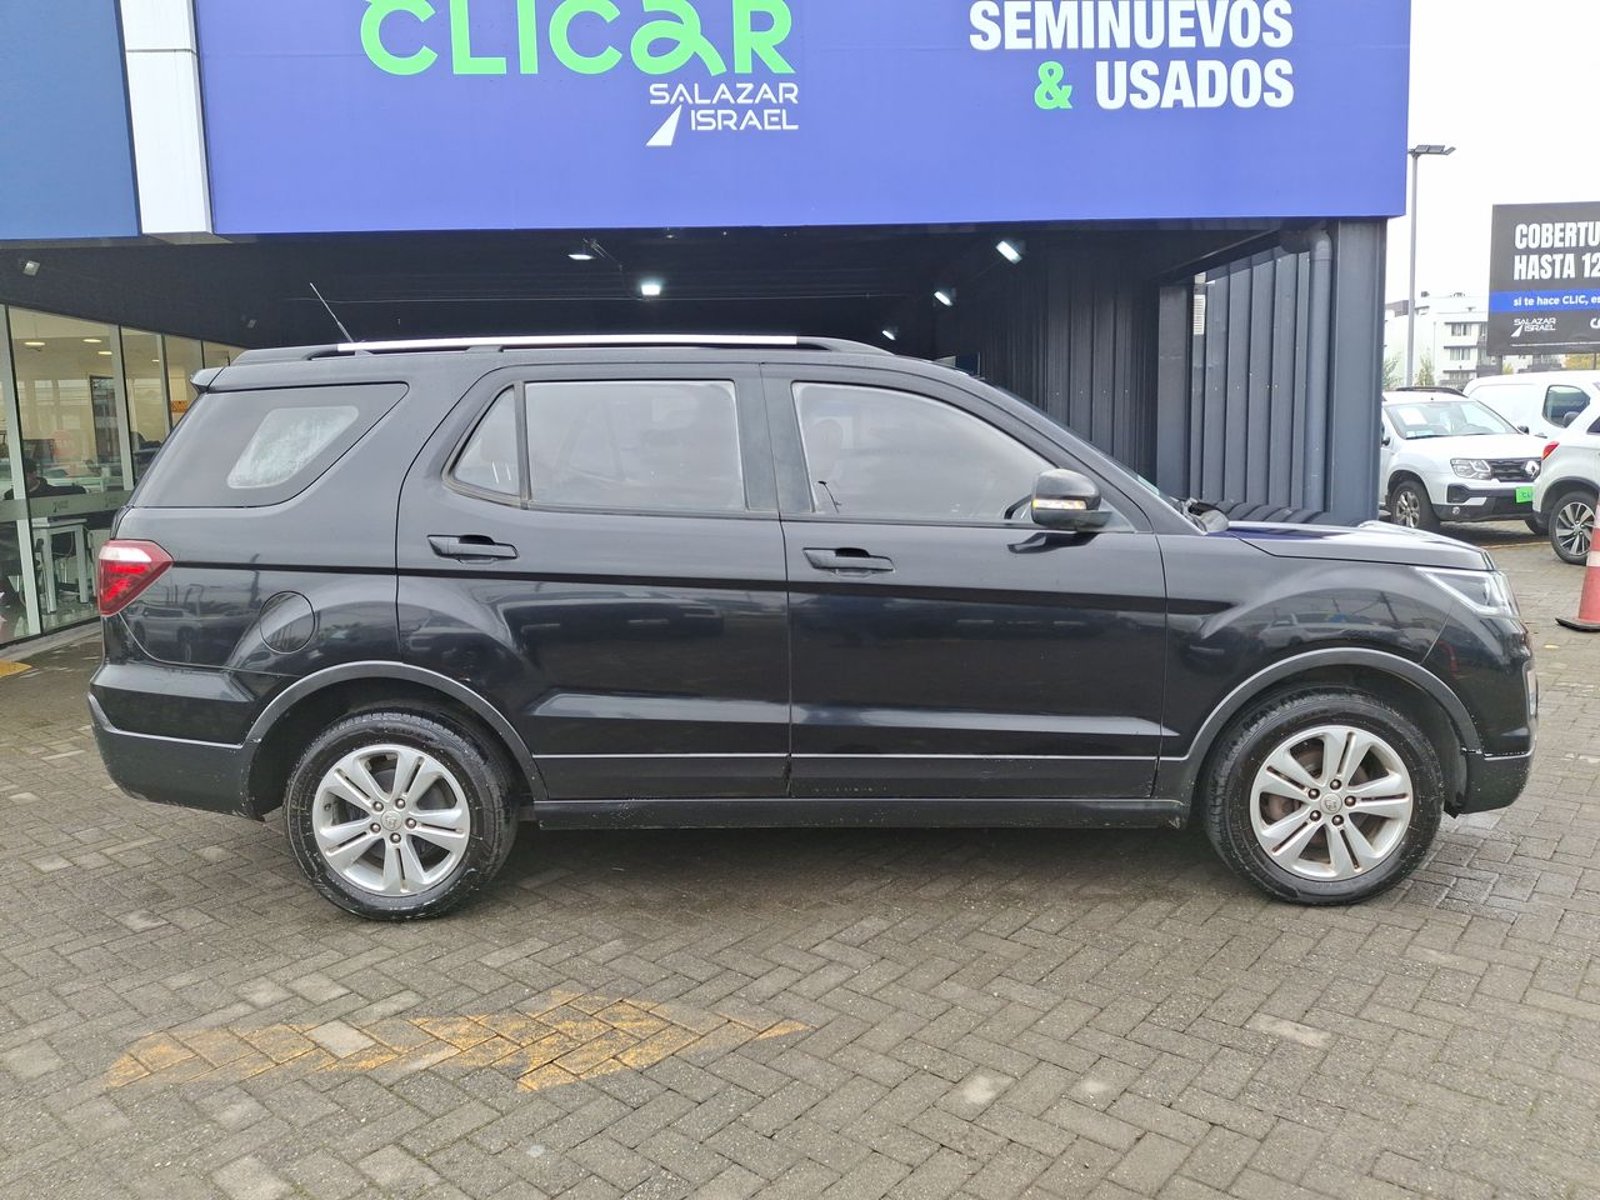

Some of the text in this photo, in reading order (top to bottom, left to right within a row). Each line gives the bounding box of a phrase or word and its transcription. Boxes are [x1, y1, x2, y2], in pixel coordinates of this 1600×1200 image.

[969, 0, 1294, 50] SEMINUEVOS
[649, 83, 799, 104] SALAZAR
[1034, 58, 1294, 110] & USADOS
[690, 109, 799, 131] ISRAEL
[1513, 252, 1600, 280] HASTA 12
[1513, 297, 1522, 306] si
[1524, 297, 1535, 306] te
[1536, 296, 1560, 306] hace
[1562, 295, 1589, 305] CLIC,
[1513, 317, 1557, 326] SALAZAR
[1524, 324, 1557, 332] ISRAEL
